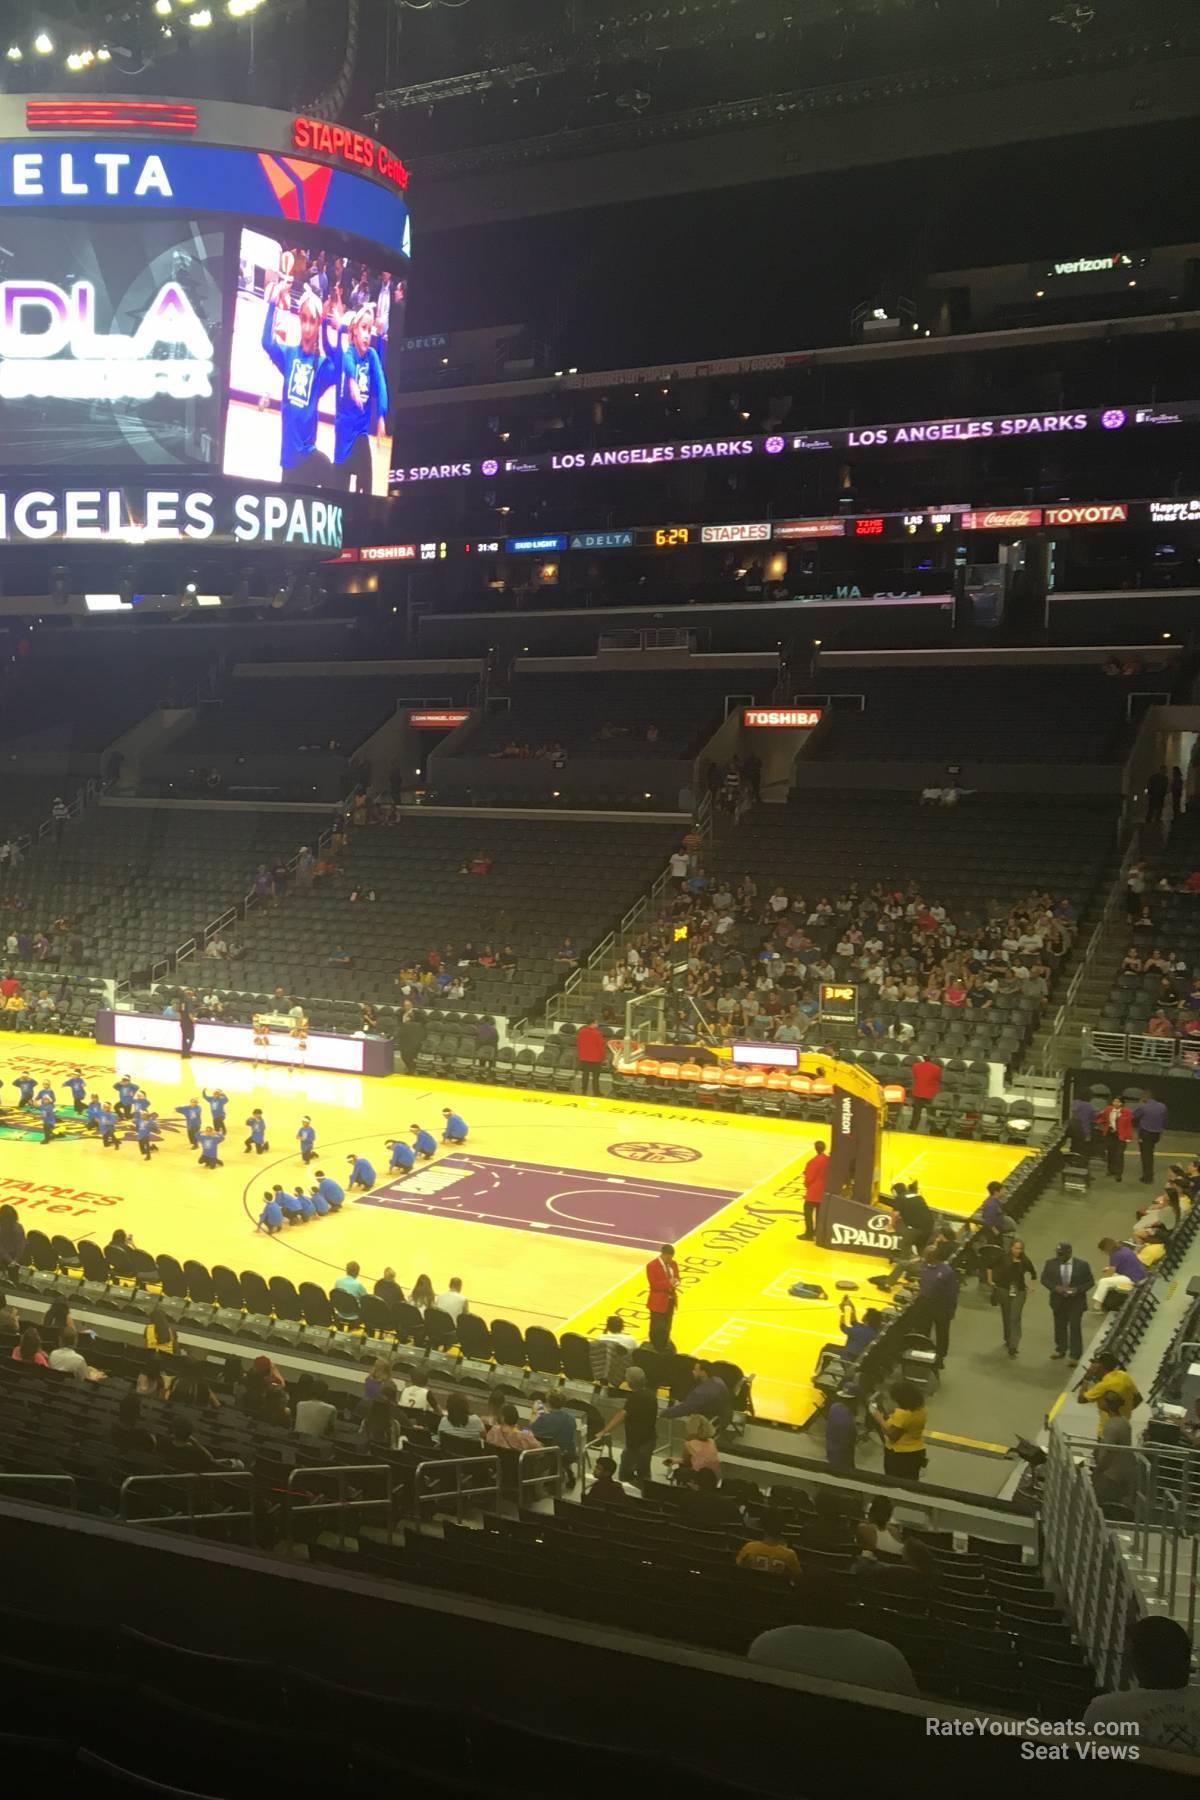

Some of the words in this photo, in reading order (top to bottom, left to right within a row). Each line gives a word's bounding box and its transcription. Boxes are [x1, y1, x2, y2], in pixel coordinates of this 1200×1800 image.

[294, 117, 374, 169] STAPLES
[1054, 257, 1113, 274] verizon
[848, 430, 889, 447] LOS
[893, 421, 994, 444] ANGELES
[1000, 414, 1087, 436] SPARKS
[552, 454, 585, 469] LOS
[590, 446, 675, 467] ANGELES
[680, 439, 754, 460] SPARKS
[409, 463, 472, 481] SPARKS
[1046, 506, 1126, 524] TOYOTA
[1150, 502, 1189, 513] Happy
[234, 494, 343, 549] SPARKS
[856, 519, 884, 528] TIME
[904, 515, 924, 525] LAS
[703, 525, 768, 542] STAPLES
[856, 526, 883, 535] OUTS
[514, 541, 533, 550] BUD
[534, 539, 558, 549] LIGHT
[585, 534, 633, 546] DELTA
[360, 546, 415, 560] TOSHIBA
[421, 551, 437, 560] LAS
[746, 711, 819, 725] TOSHIBA
[6, 1055, 119, 1074] STAPLES
[608, 1106, 730, 1126] SPARKS
[842, 1097, 853, 1135] verizon
[701, 1201, 806, 1255] SPARKS
